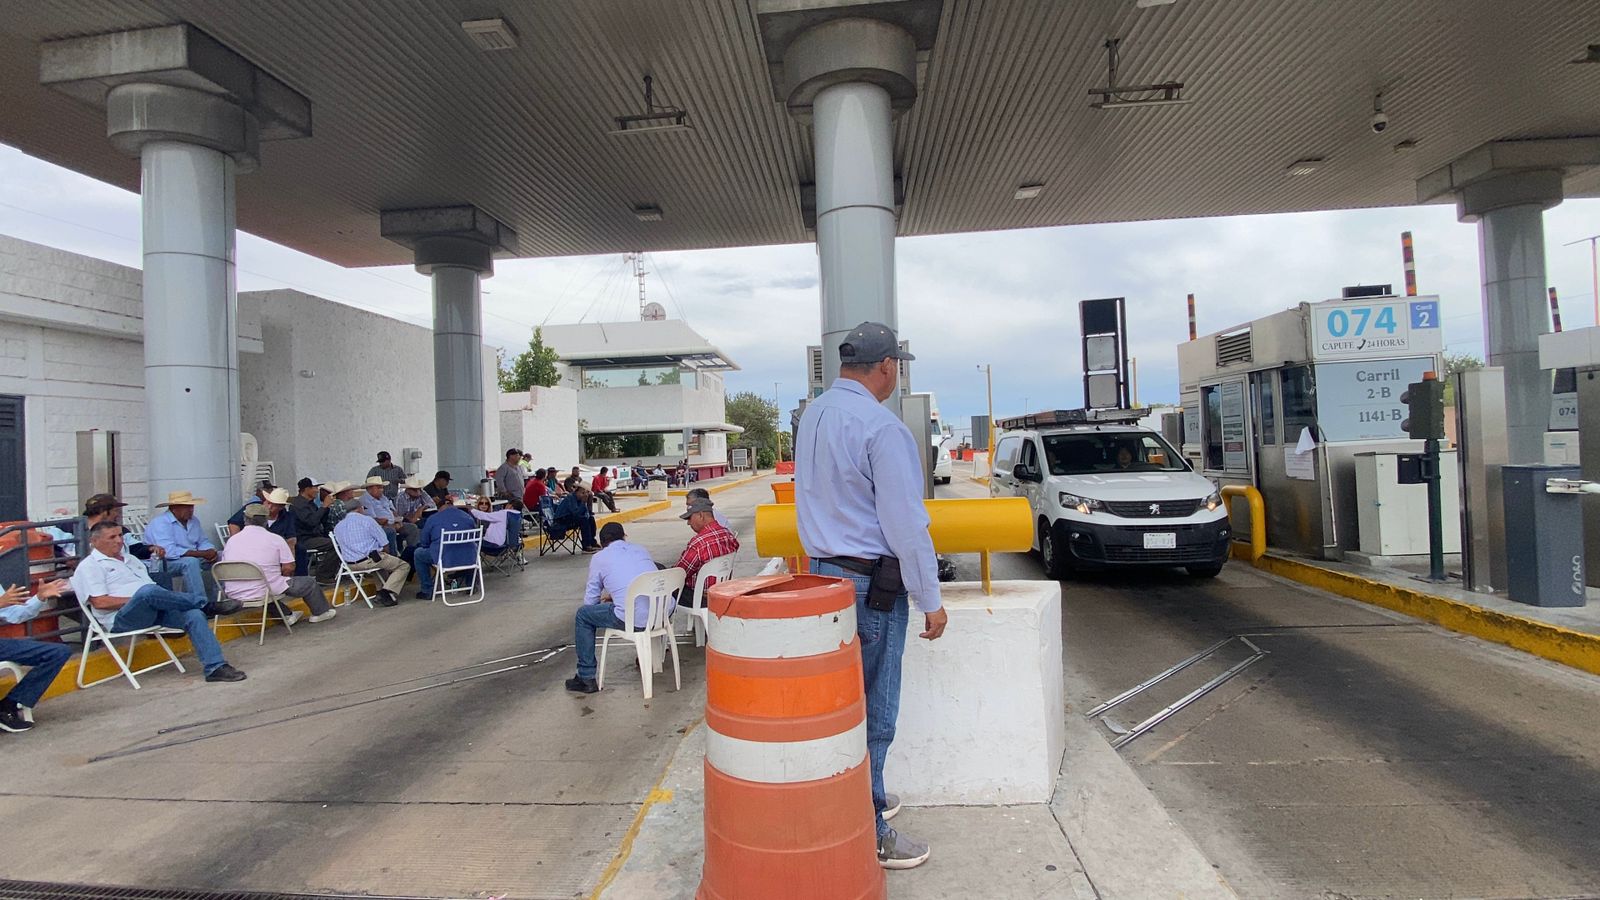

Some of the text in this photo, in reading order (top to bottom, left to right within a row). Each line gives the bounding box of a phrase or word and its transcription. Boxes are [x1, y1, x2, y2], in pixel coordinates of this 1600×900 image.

[1327, 307, 1397, 337] 074
[1419, 312, 1430, 327] 2
[1322, 342, 1354, 350] CAPUFE
[1377, 339, 1405, 347] HORAS
[1356, 369, 1400, 382] Carril
[1367, 387, 1391, 399] 2-B
[1359, 409, 1402, 422] 1141-B
[1559, 407, 1576, 416] 074
